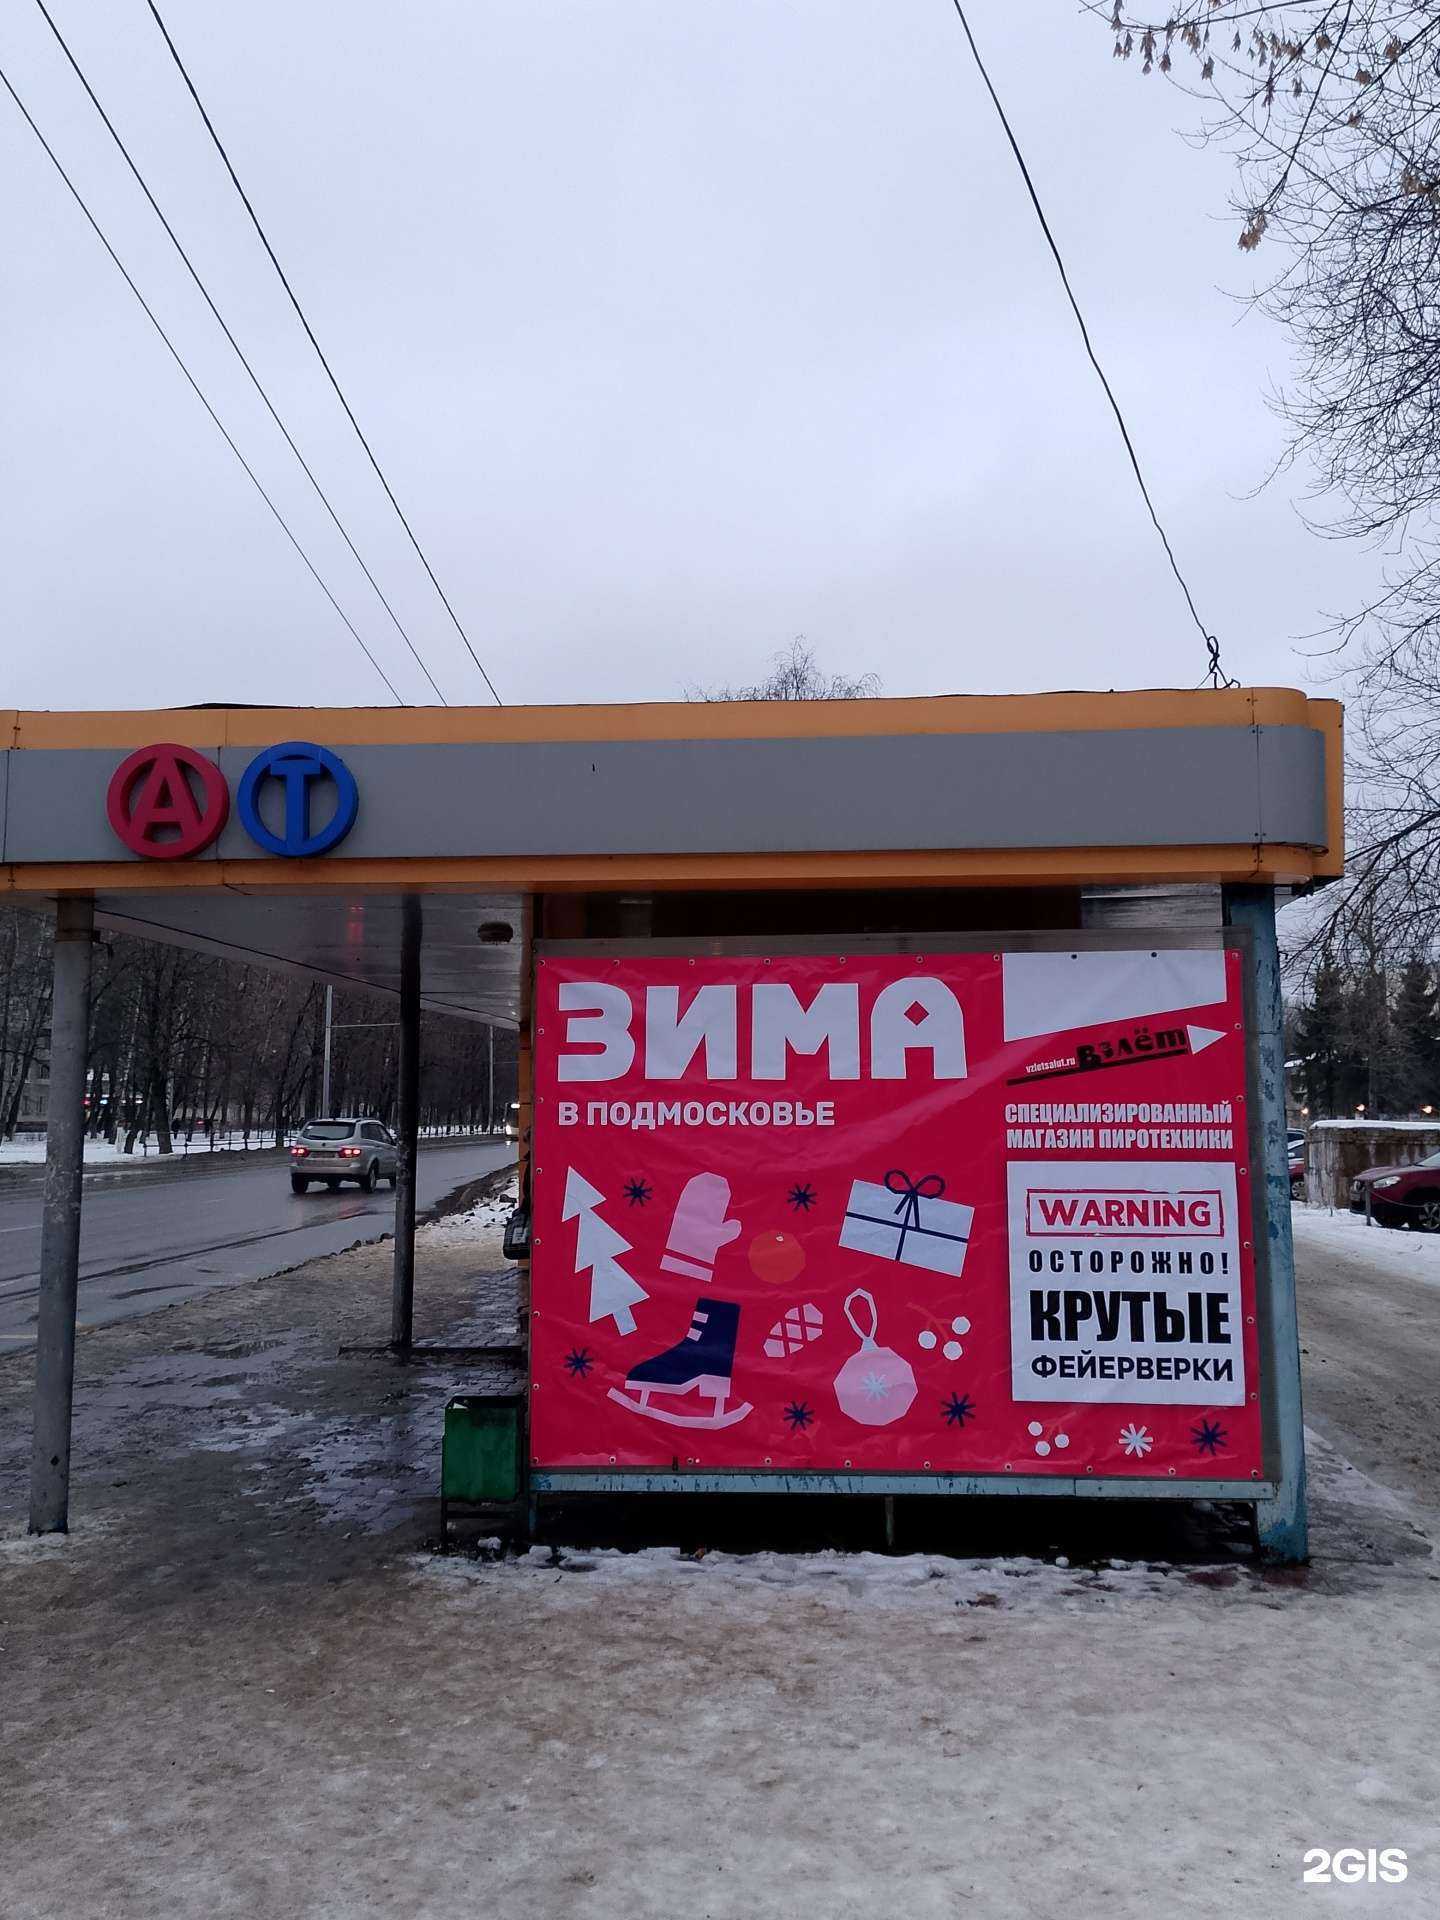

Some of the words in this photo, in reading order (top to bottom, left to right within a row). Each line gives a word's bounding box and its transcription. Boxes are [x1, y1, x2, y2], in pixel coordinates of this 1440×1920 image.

[557, 976, 968, 1082] ЗИМА
[558, 1102, 579, 1126] В
[587, 1102, 835, 1129] ПОДМОСКОВЬЕ
[1005, 1101, 1233, 1125] СПЕЦИАЛИЗИРОВАННЫЙ
[1007, 1129, 1094, 1149] МАГАЗИН
[1100, 1129, 1233, 1149] ПИРОТЕХНИКИ
[1038, 1199, 1211, 1227] WARNING
[1029, 1250, 1228, 1274] ОСТОРОЖНО!
[1029, 1290, 1232, 1344] КРУТЫЕ
[1031, 1350, 1233, 1381] ФЕЙЕРВЕРКИ
